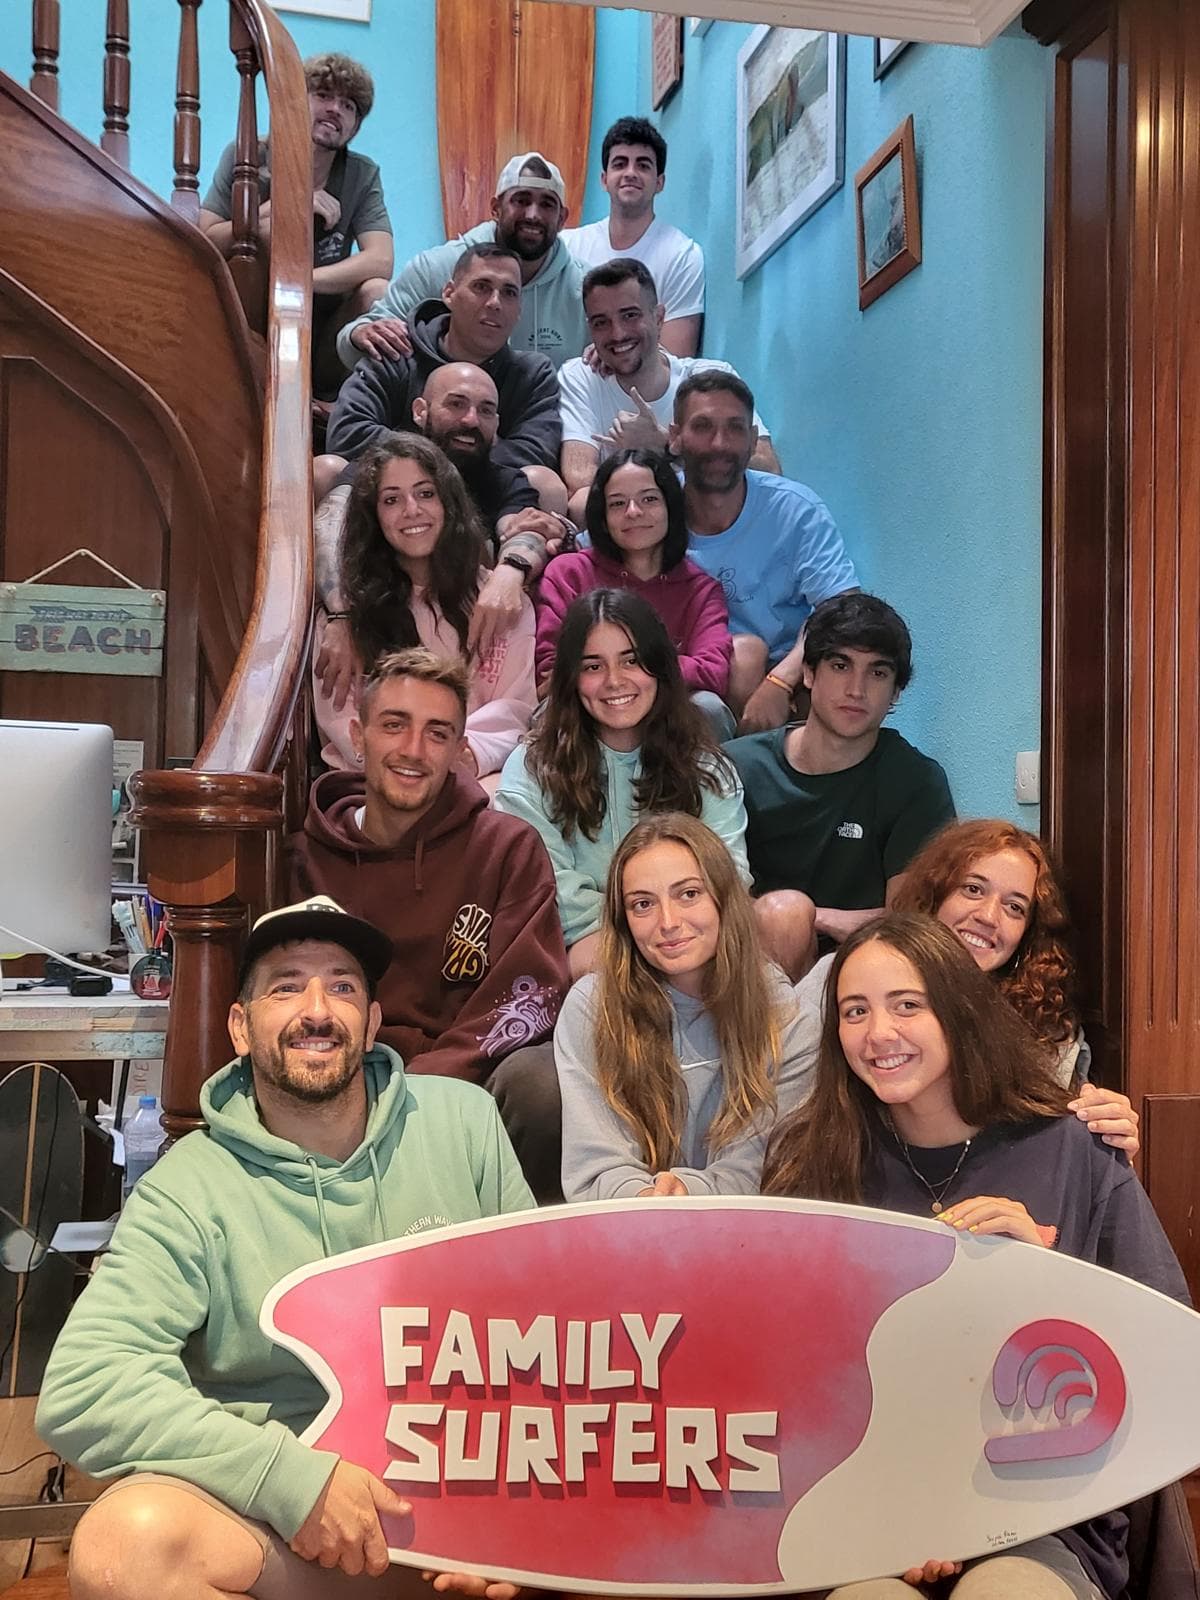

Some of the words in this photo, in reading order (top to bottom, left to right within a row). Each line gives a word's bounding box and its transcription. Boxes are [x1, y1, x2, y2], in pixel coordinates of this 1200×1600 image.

[15, 624, 151, 655] BEACH
[403, 1215, 431, 1237] THERN
[433, 1214, 454, 1227] WAV
[380, 1306, 684, 1391] FAMILY
[382, 1402, 781, 1492] SURFERS
